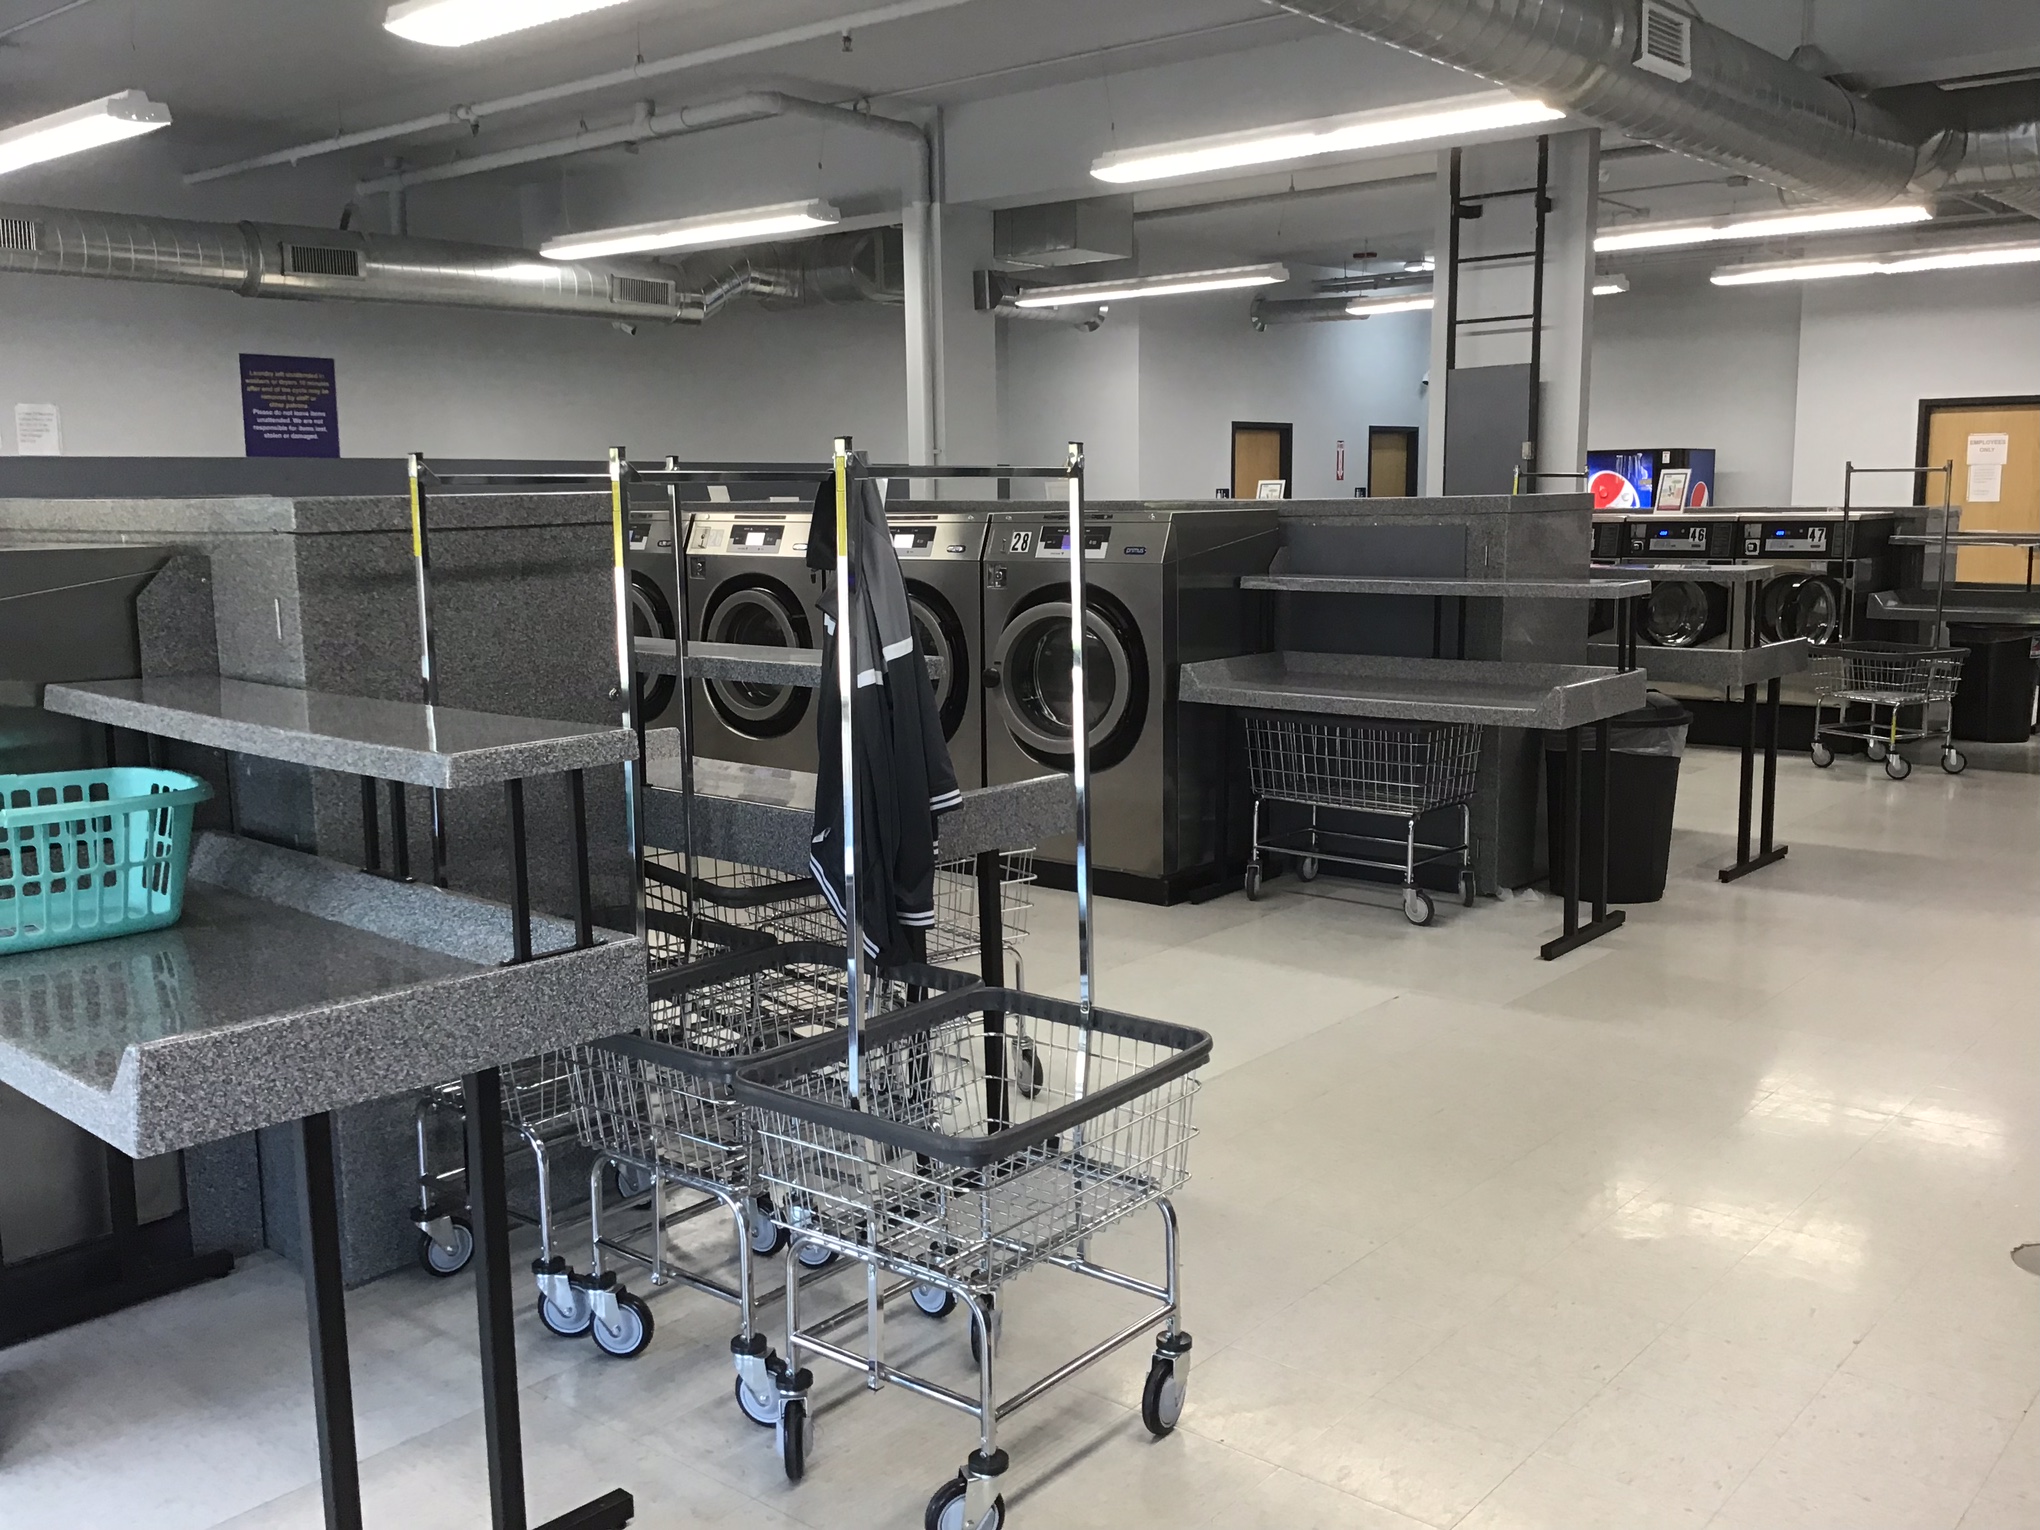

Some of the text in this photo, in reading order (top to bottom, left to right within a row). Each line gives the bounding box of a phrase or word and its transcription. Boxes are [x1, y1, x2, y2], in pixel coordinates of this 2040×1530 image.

[1011, 532, 1030, 552] 28
[1690, 528, 1705, 542] 46
[1808, 528, 1825, 542] 47
